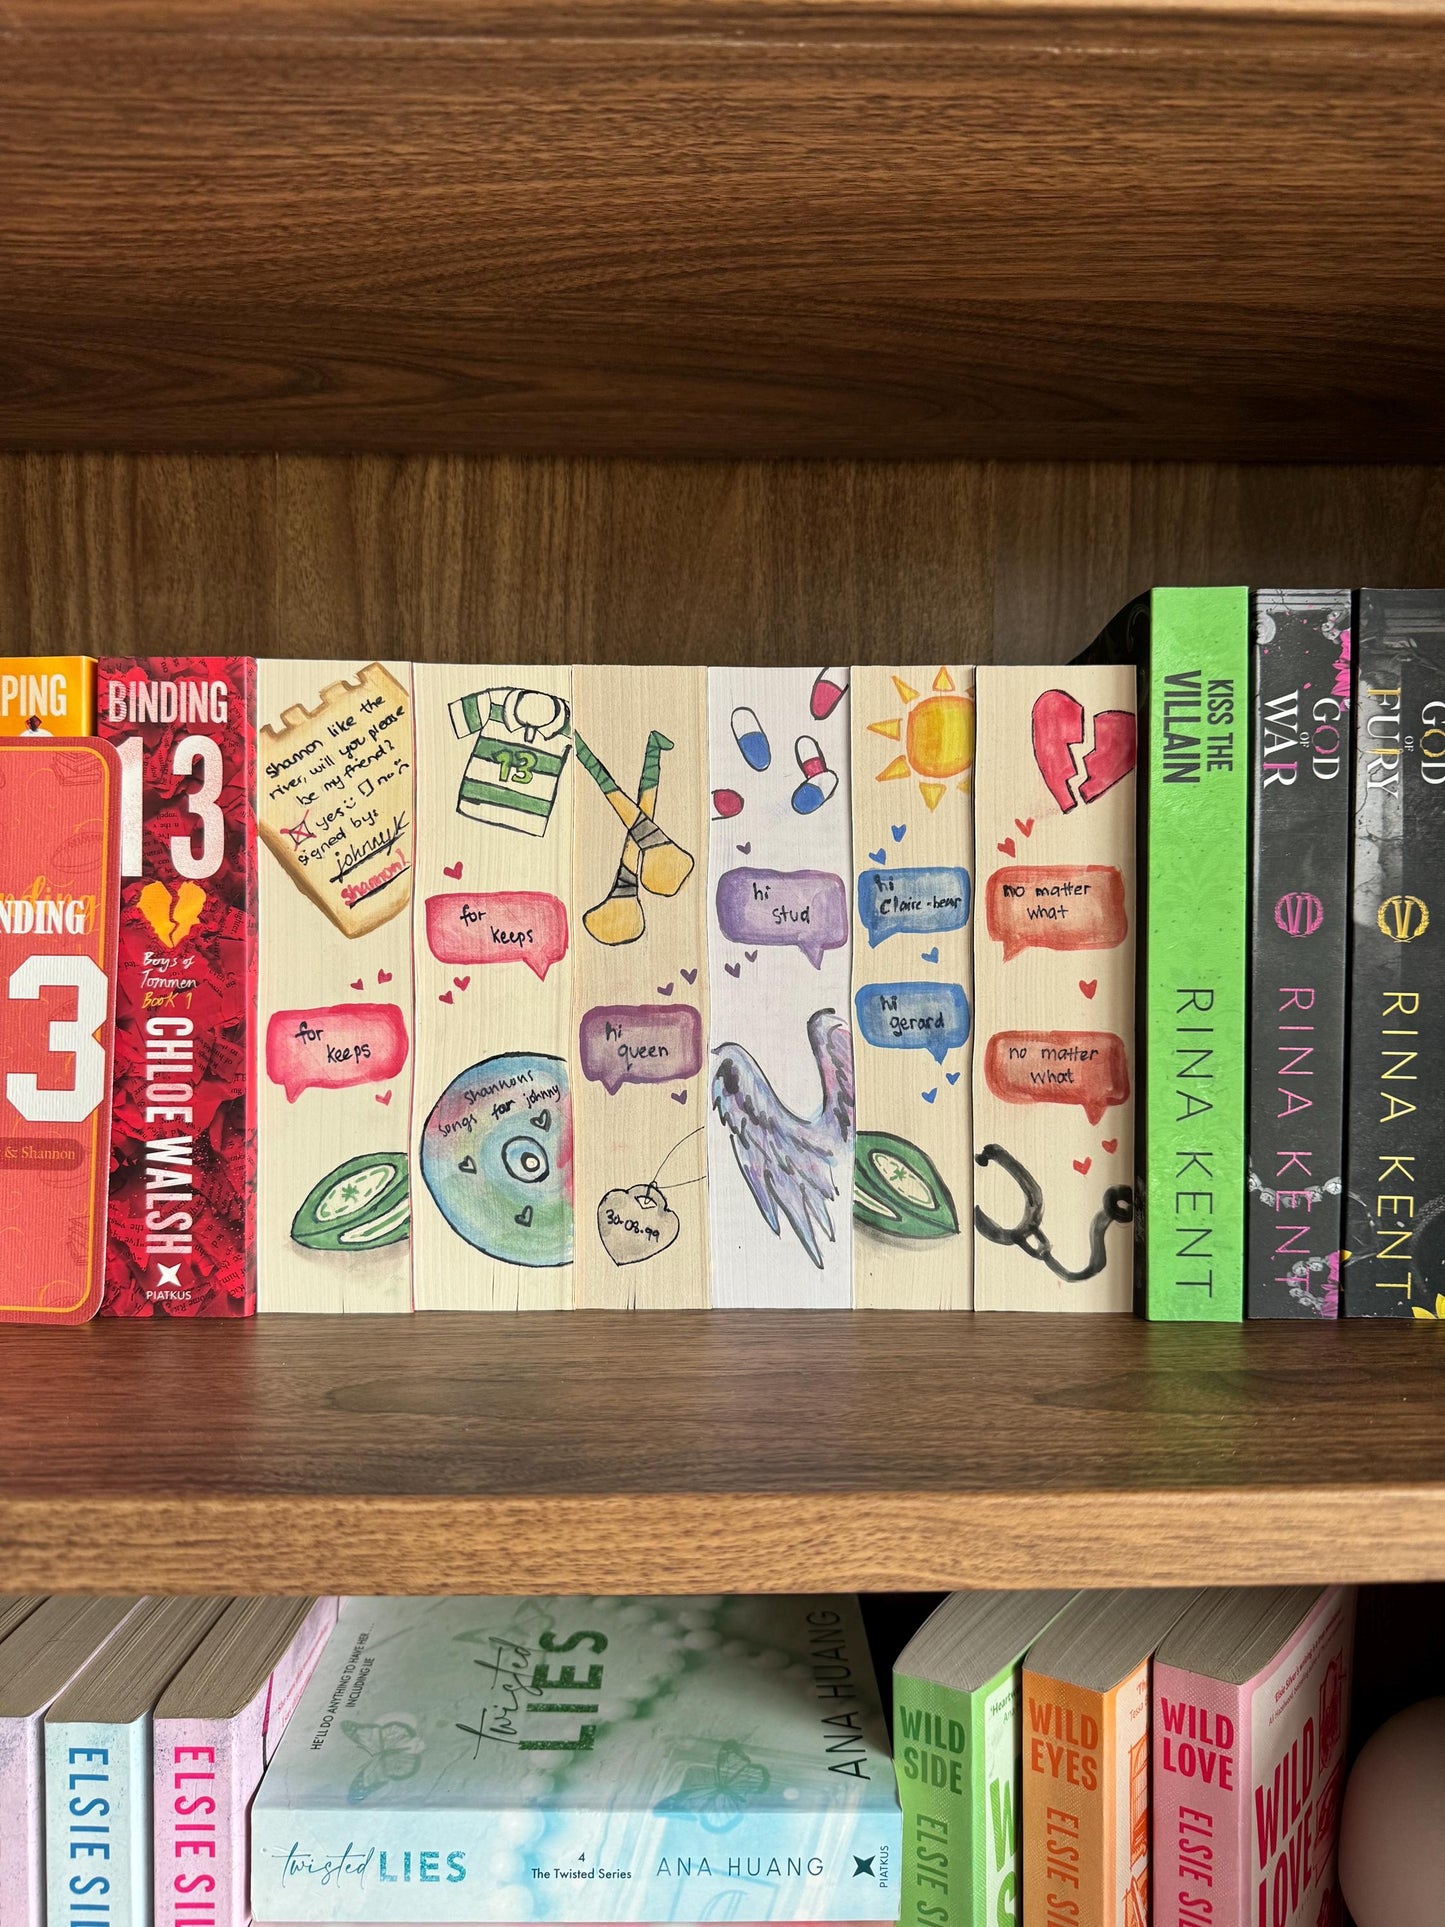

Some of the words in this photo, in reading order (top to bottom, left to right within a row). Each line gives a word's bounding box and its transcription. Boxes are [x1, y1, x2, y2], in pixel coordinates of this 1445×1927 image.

[2, 673, 67, 717] PING
[108, 680, 228, 723] BINDING
[1207, 679, 1235, 726] KISS
[327, 715, 357, 738] like
[360, 696, 386, 714] the
[1162, 669, 1202, 784] VILLAIN
[309, 755, 335, 776] will
[339, 736, 366, 760] you
[368, 705, 405, 742] please
[1206, 732, 1234, 773] THE
[1263, 689, 1300, 790] WAR
[1299, 731, 1311, 750] OF
[1312, 697, 1341, 781] GOD
[1366, 688, 1405, 799] FURY
[1403, 735, 1416, 753] OF
[296, 791, 320, 806] be
[323, 775, 345, 792] my
[344, 739, 395, 779] friend?
[495, 750, 538, 785] 13
[116, 734, 225, 880] 13
[315, 807, 345, 831] yes
[752, 882, 771, 901] hi
[874, 873, 894, 893] hi
[1002, 884, 1026, 898] no
[1035, 881, 1092, 898] matter
[459, 904, 487, 928] for
[771, 904, 811, 925] stud
[1026, 904, 1069, 920] what
[490, 926, 534, 948] keeps
[140, 968, 197, 988] Tommen
[143, 952, 178, 972] Boys
[183, 955, 195, 969] of
[186, 992, 193, 1010] 1
[880, 994, 898, 1011] hi
[295, 1021, 324, 1045] for
[604, 1021, 624, 1042] hi
[889, 1011, 945, 1037] gerard
[146, 1017, 194, 1123] CHLOE
[326, 1043, 371, 1064] keeps
[617, 1043, 669, 1071] queen
[1009, 1047, 1027, 1060] no
[1041, 1046, 1099, 1061] matter
[1176, 988, 1214, 1122] RINA
[1277, 987, 1315, 1118] RINA
[1379, 991, 1419, 1123] RINA
[523, 1084, 561, 1109] johnny
[1030, 1068, 1075, 1084] what
[21, 1145, 76, 1160] Shannon
[146, 1136, 194, 1254] WALSH
[1175, 1151, 1214, 1298] KENT
[1274, 1151, 1313, 1292] KENT
[1375, 1155, 1416, 1300] KENT
[146, 1290, 192, 1300] PIATKUS
[343, 1663, 356, 1677] TO
[348, 1645, 366, 1666] HAVE
[806, 1609, 855, 1701] HUANG
[327, 1674, 352, 1714] ANYTHING
[346, 1669, 370, 1708] INCLUDING
[363, 1657, 375, 1671] LIE
[518, 1630, 608, 1750] LIES
[320, 1714, 335, 1733] DO
[900, 1705, 965, 1754] WILD
[1028, 1697, 1098, 1750] WILD
[1160, 1697, 1234, 1750] WILD
[822, 1711, 871, 1781] ANA
[1031, 1737, 1098, 1792] EYES
[1163, 1736, 1233, 1791] LOVE
[903, 1747, 963, 1796] SIDE
[69, 1748, 110, 1860] ELSIE
[174, 1746, 216, 1858] ELSIE
[1255, 1716, 1314, 1871] WILD
[271, 1840, 377, 1890] twisted
[379, 1850, 468, 1884] LIES
[577, 1851, 587, 1863] 4
[656, 1857, 714, 1877] ANA
[727, 1857, 825, 1877] HUANG
[878, 1845, 890, 1888] PIATKUS
[916, 1813, 949, 1895] ELSIE
[1046, 1806, 1080, 1890] ELSIE
[1178, 1805, 1213, 1888] ELSIE
[531, 1867, 552, 1880] The
[553, 1867, 597, 1880] Twisted
[598, 1867, 632, 1880] Series
